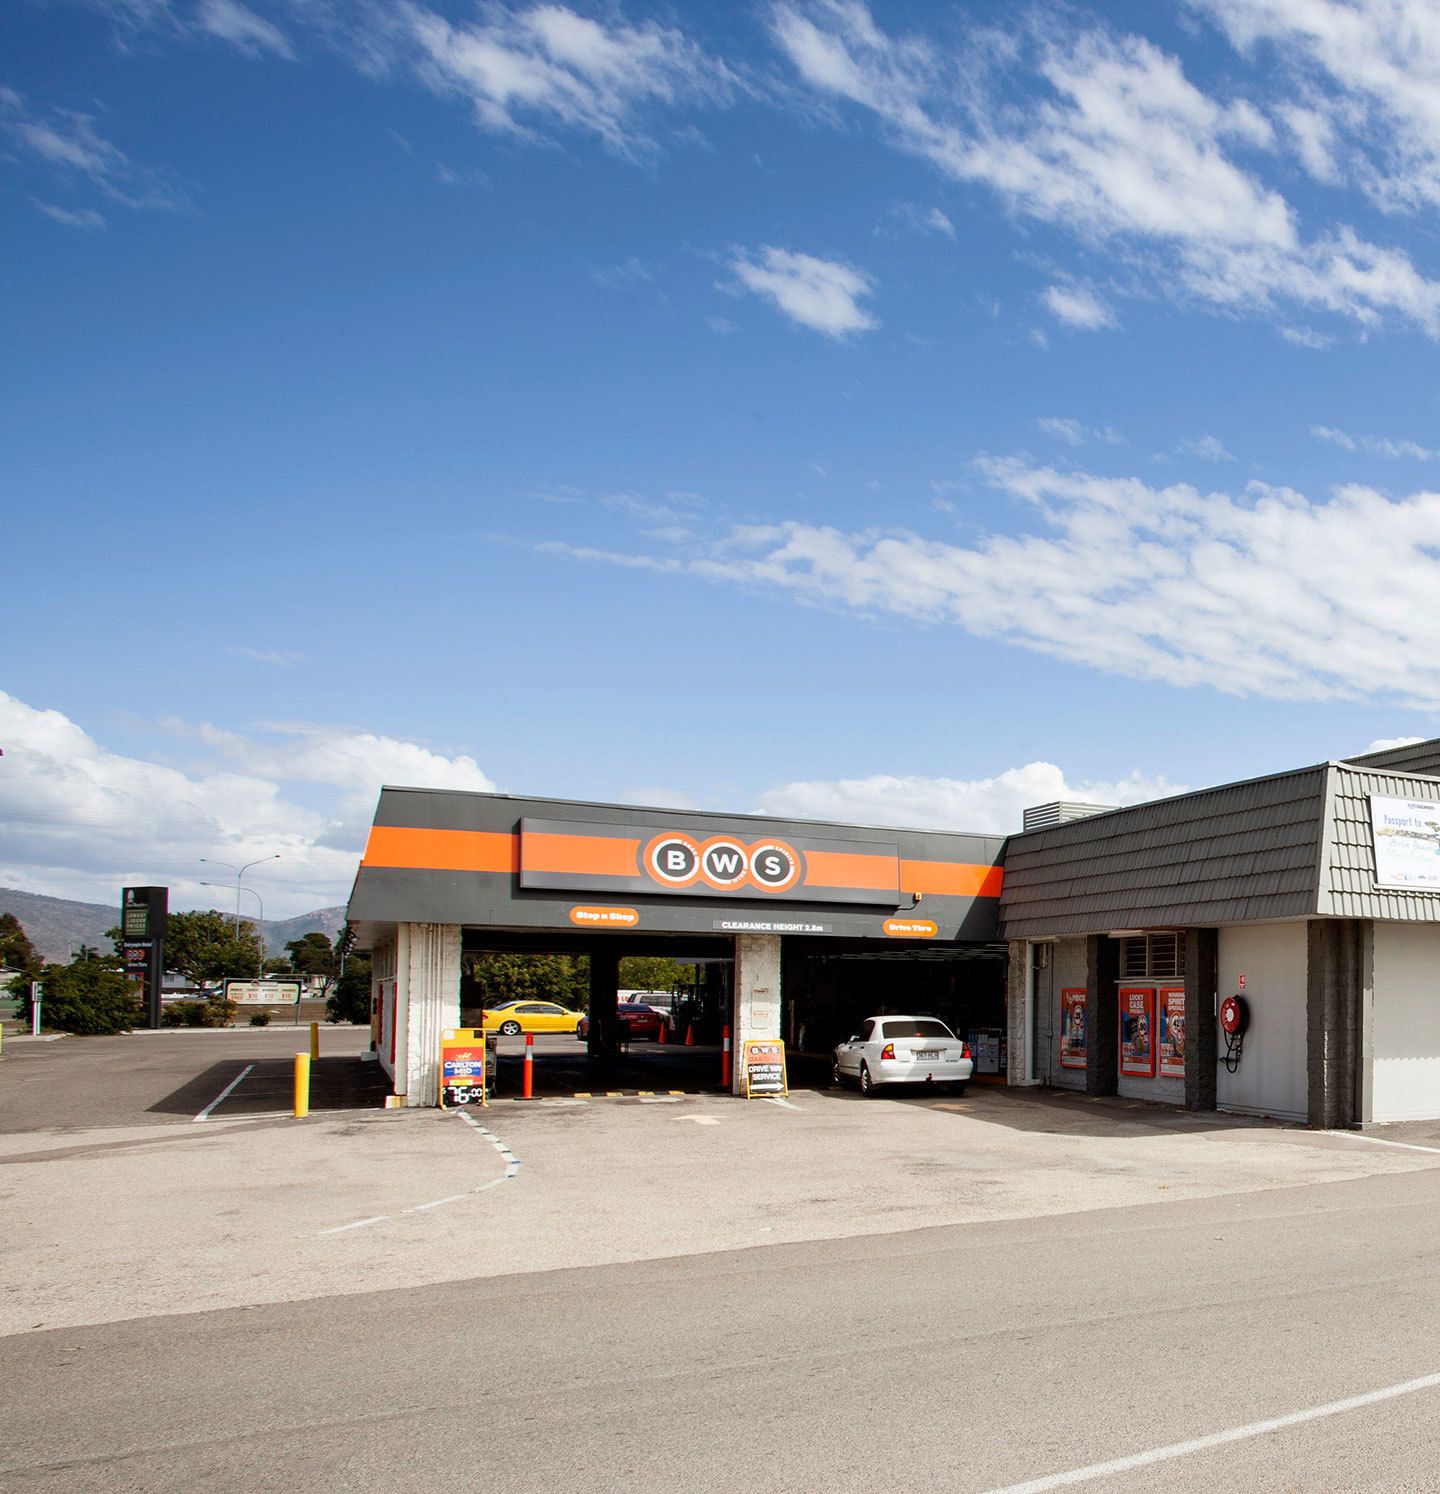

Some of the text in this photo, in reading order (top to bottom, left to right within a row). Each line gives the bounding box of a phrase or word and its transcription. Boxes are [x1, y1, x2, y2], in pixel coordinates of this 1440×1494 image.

[1384, 814, 1422, 828] Passport to
[576, 911, 600, 921] Stop
[608, 912, 635, 922] Shop
[721, 920, 772, 931] CLEARANCE
[772, 922, 804, 931] HEIGHT
[889, 923, 932, 932] Drive Thru
[1129, 1000, 1144, 1009] CASE
[454, 1067, 473, 1075] MID
[749, 1065, 783, 1073] DRIVE WAY
[752, 1073, 782, 1081] SERVICE
